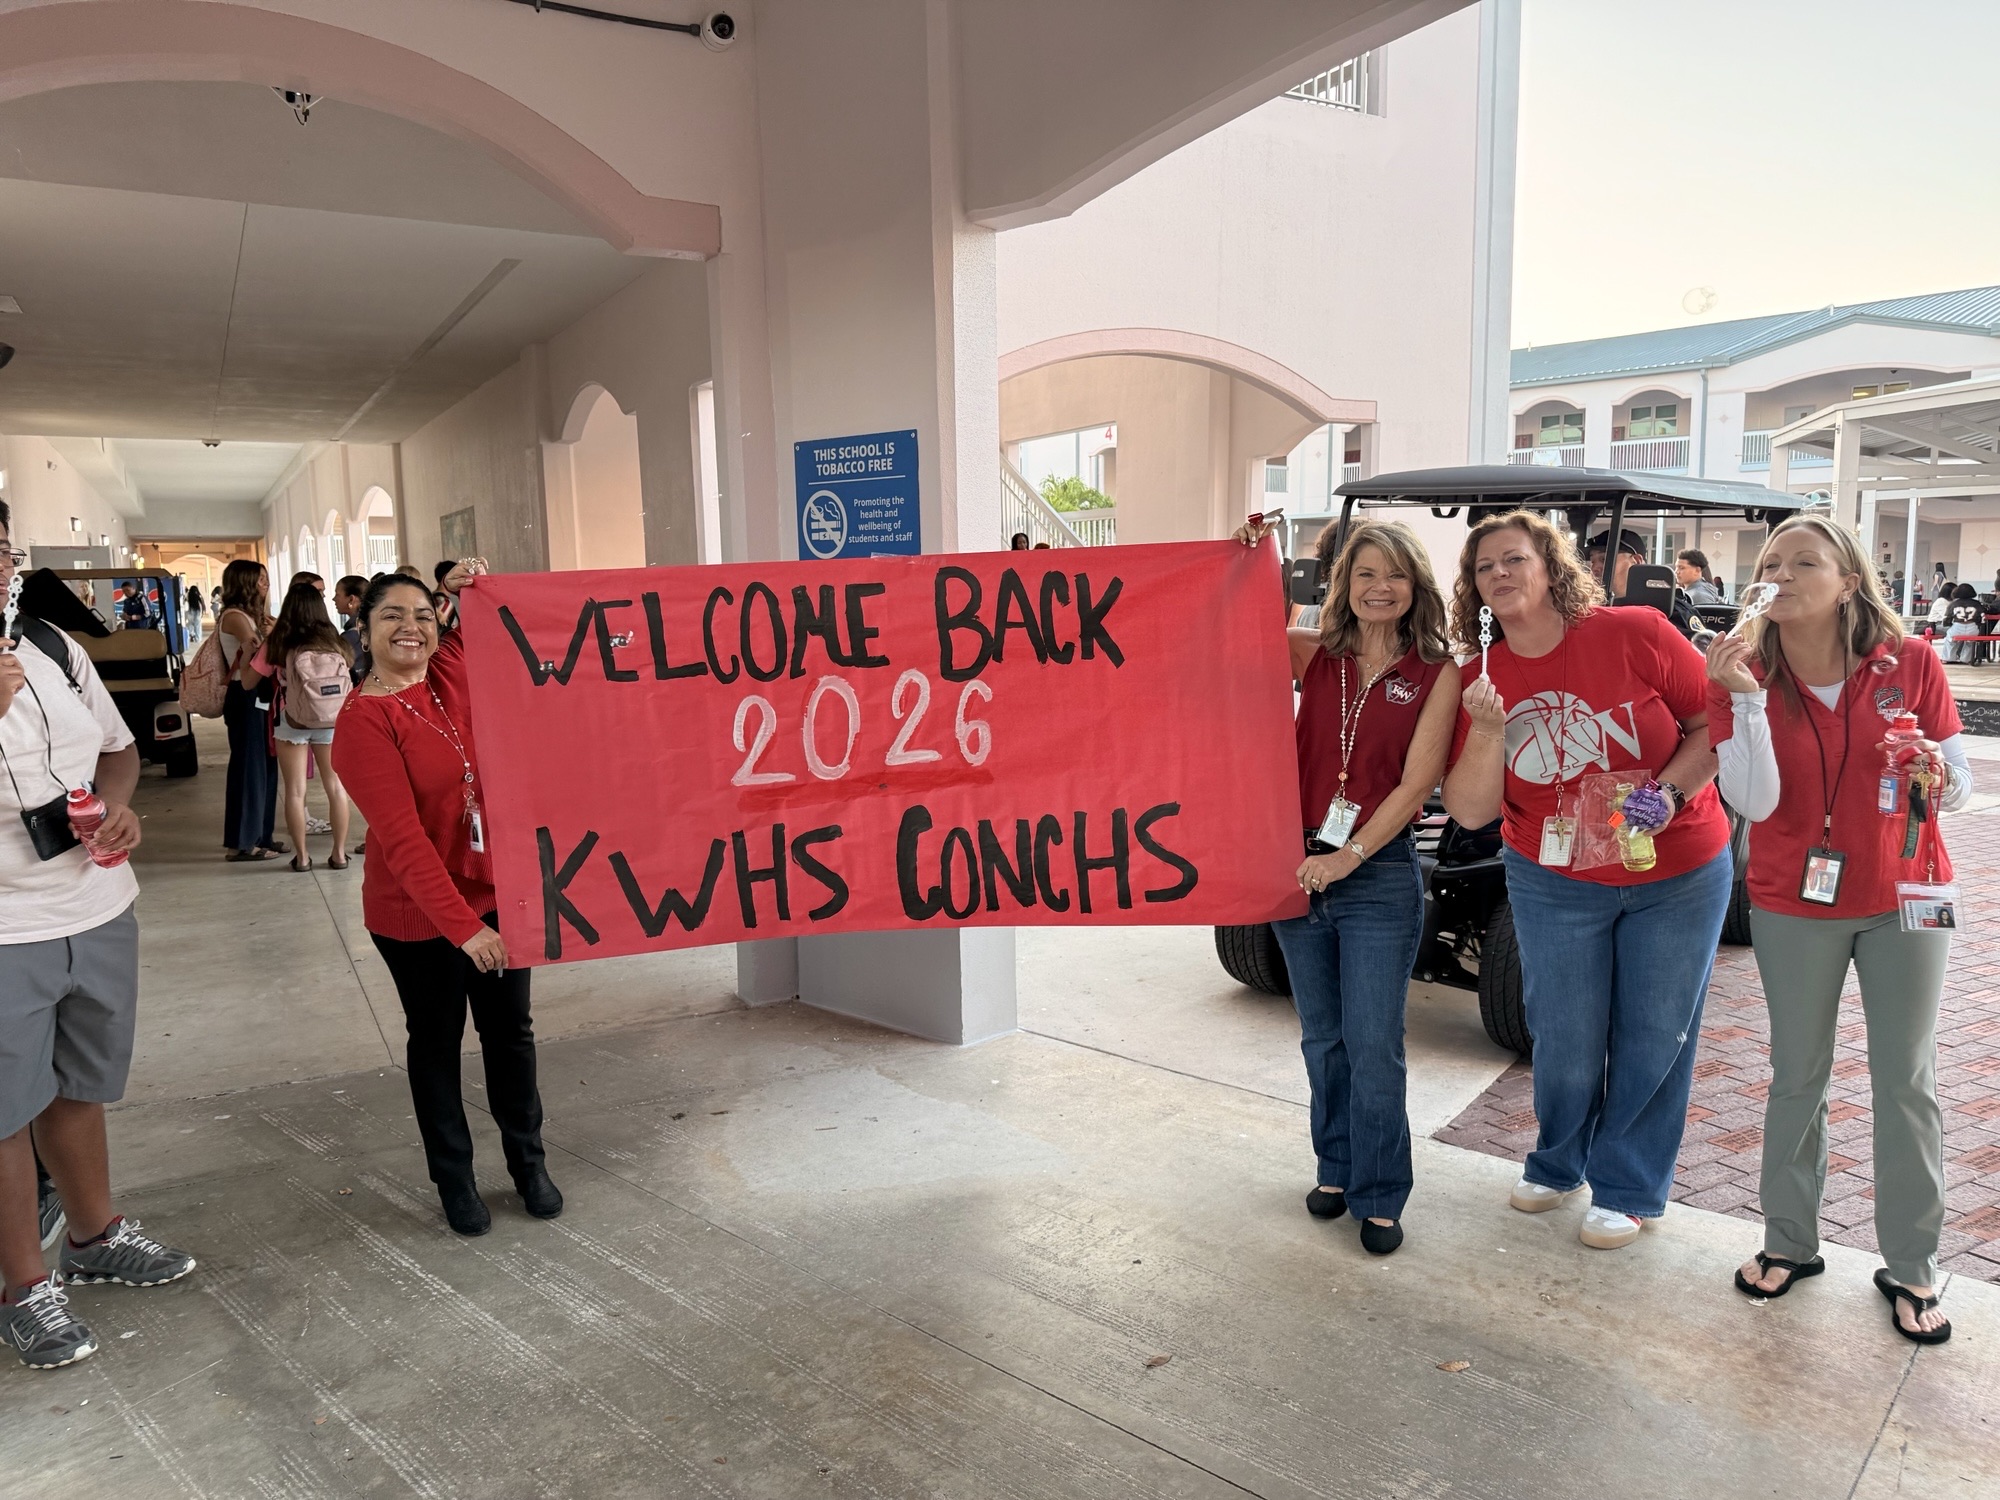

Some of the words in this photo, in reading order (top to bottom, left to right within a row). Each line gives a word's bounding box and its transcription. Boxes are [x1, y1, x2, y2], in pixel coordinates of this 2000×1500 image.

[1105, 425, 1113, 441] 4
[814, 448, 836, 462] THIS
[839, 444, 882, 459] SCHOOL
[885, 442, 895, 455] IS
[816, 461, 865, 476] TOBACCO
[868, 458, 893, 472] FREE
[853, 497, 891, 507] Promoting
[891, 496, 905, 505] the
[860, 509, 883, 519] health
[884, 508, 898, 517] and
[858, 521, 892, 532] wellbeing
[893, 520, 902, 529] of
[848, 534, 879, 543] students
[880, 533, 894, 542] and
[895, 532, 913, 541] staff
[497, 581, 890, 687] WELCOME
[935, 567, 1124, 682] BACK
[1700, 615, 1726, 624] EPIC
[1391, 684, 1413, 700] KW
[731, 669, 993, 787] 2026
[1524, 701, 1642, 779] KW
[1637, 796, 1660, 809] Year!
[1629, 808, 1657, 825] Happy
[536, 823, 850, 960] KWHS
[896, 802, 1199, 920] CONCHS
